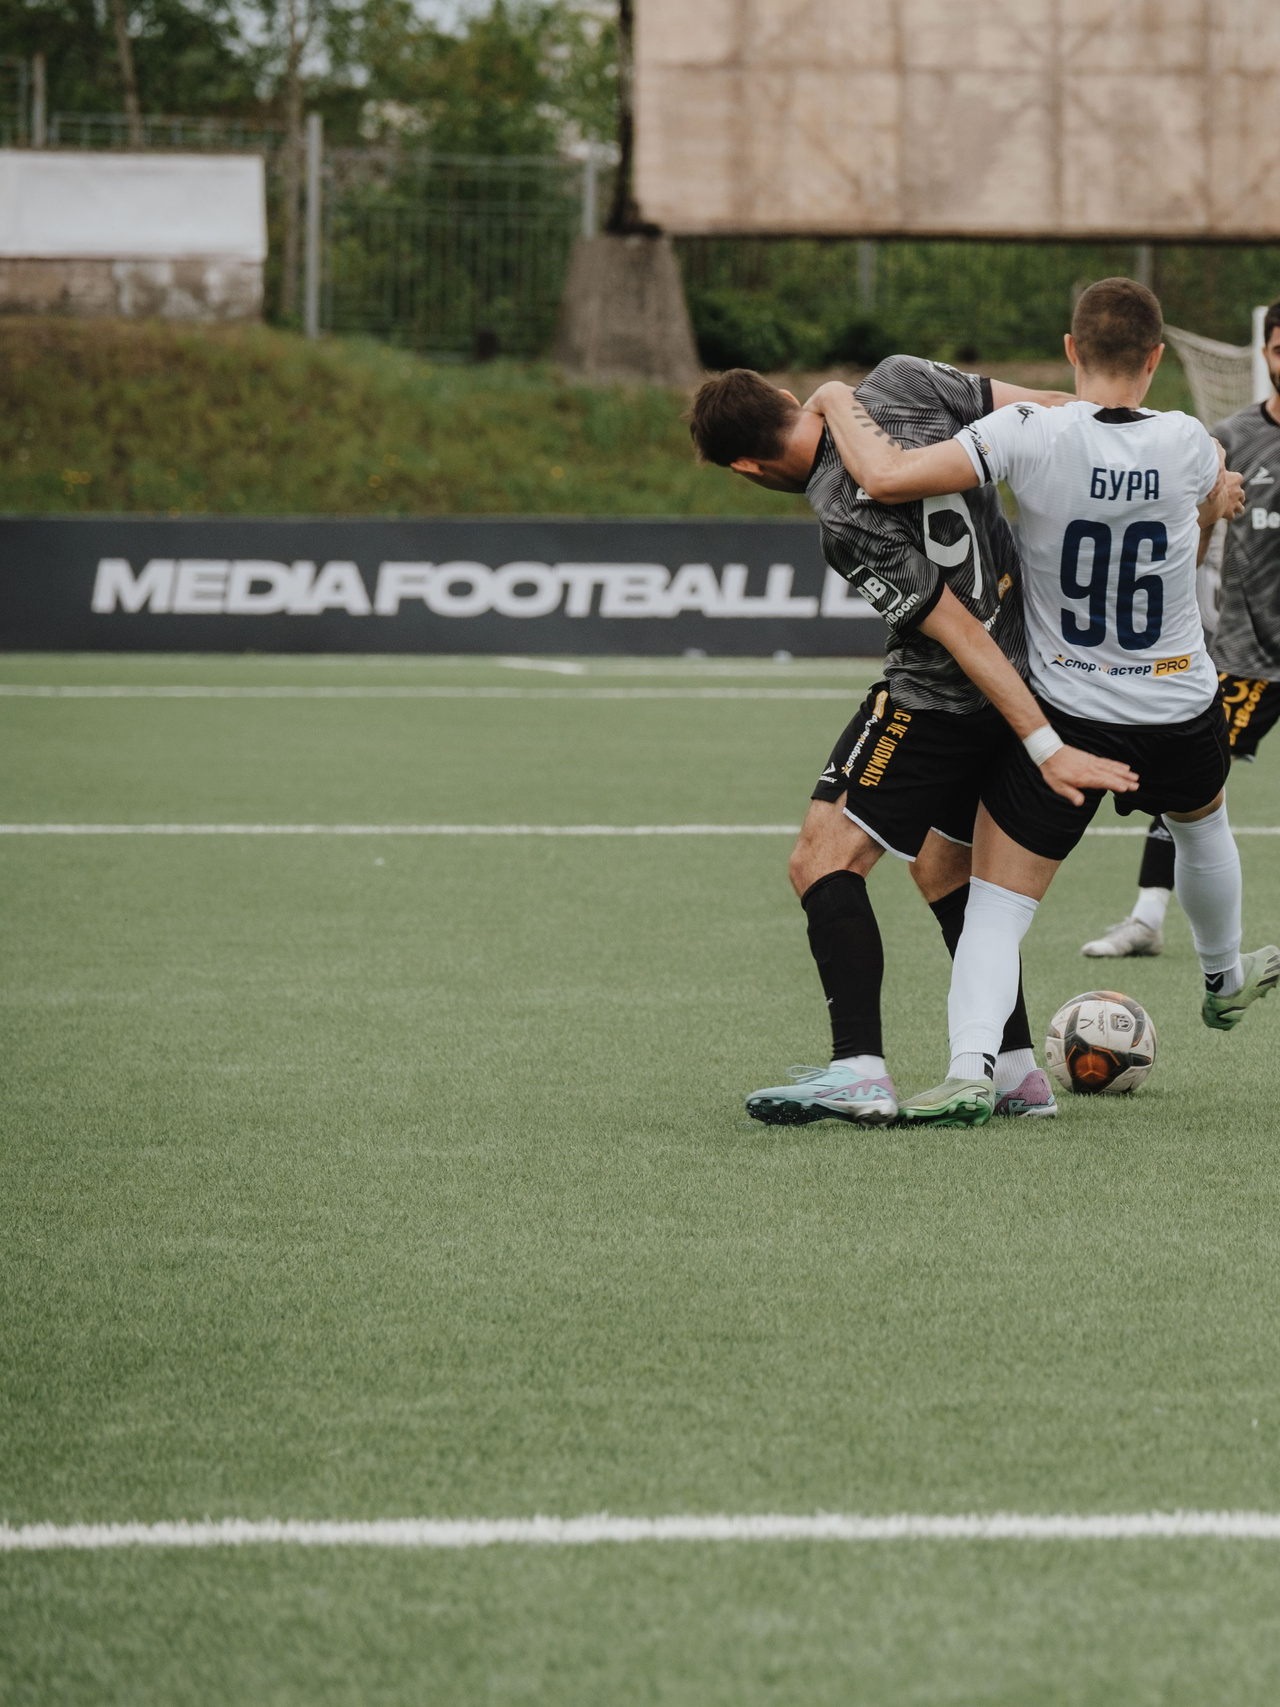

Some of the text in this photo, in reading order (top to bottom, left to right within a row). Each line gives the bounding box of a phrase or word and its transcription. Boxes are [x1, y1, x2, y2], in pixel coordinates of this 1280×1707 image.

[1090, 468, 1160, 501] БУРА
[92, 557, 372, 616] MEDIA
[374, 560, 818, 618] FOOTBALL
[1060, 519, 1168, 651] 96
[1064, 658, 1189, 676] спорастер PRO
